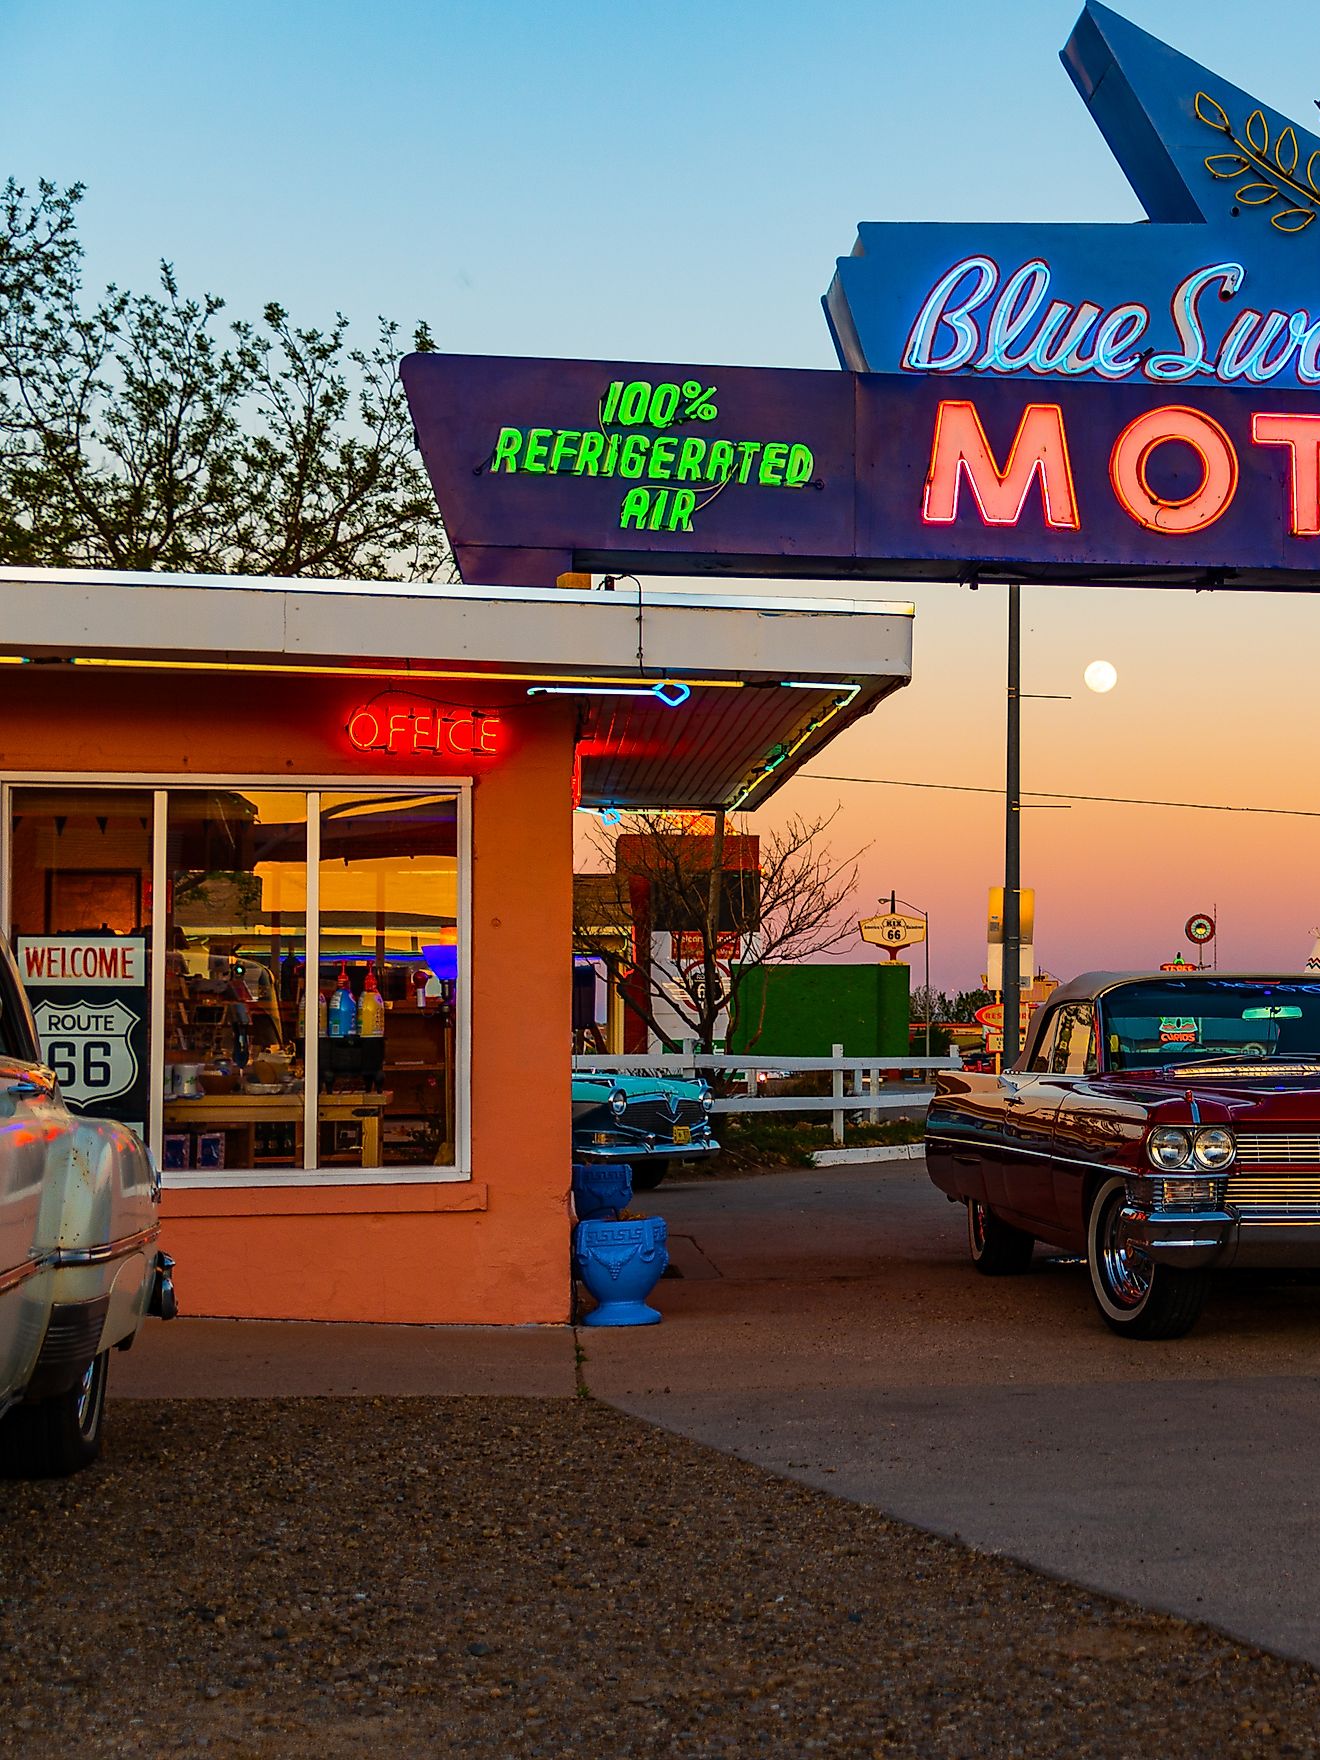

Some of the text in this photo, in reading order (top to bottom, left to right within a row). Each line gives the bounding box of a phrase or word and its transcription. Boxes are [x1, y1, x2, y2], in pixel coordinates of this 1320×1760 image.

[902, 255, 1156, 377] Blue
[602, 380, 718, 428] 100%
[490, 427, 815, 487] REFRIGERATED
[619, 488, 697, 532] AIR
[348, 708, 501, 756] OFFICE
[887, 930, 901, 940] 66
[24, 946, 135, 979] WELCOME
[48, 1014, 115, 1031] ROUTE
[1160, 1033, 1196, 1042] CURIOS
[47, 1041, 112, 1088] 66
